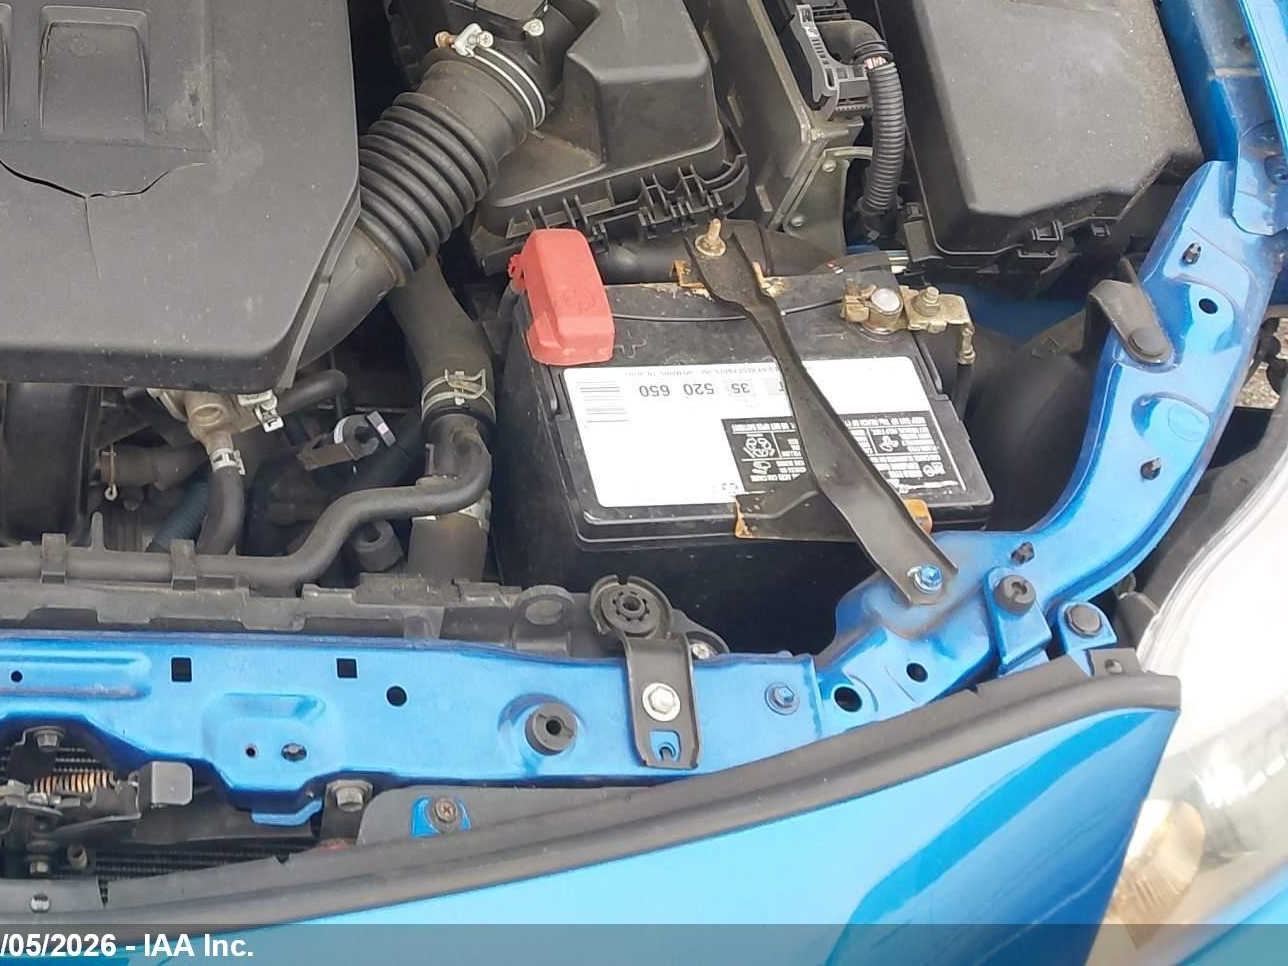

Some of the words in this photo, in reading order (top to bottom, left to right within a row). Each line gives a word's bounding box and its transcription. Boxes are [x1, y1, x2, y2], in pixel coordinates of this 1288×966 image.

[639, 384, 670, 397] 650
[683, 383, 715, 396] 520
[730, 382, 751, 394] 35
